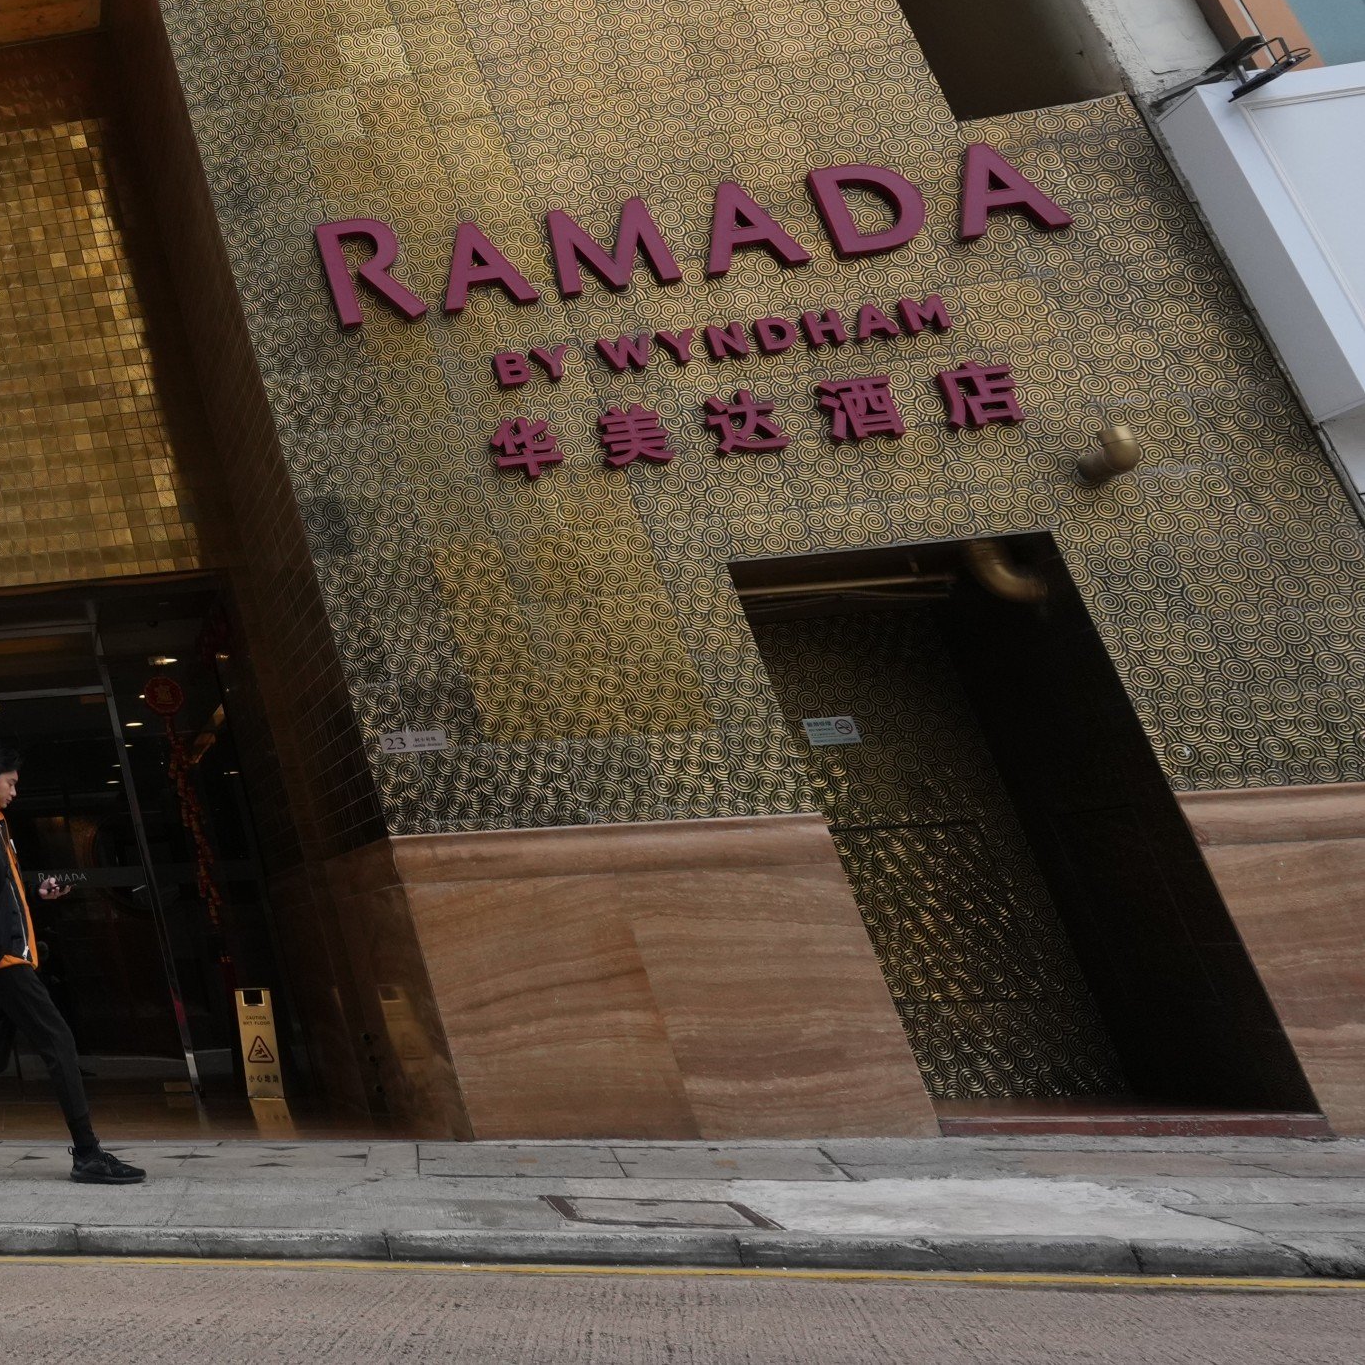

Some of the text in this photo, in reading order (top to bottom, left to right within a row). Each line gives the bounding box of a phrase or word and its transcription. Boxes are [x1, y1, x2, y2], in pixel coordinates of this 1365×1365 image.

[316, 143, 1074, 328] RAMADA
[493, 294, 952, 386] BY WYNDHAM
[490, 360, 1025, 479] 华美达酒店
[385, 737, 406, 750] 23
